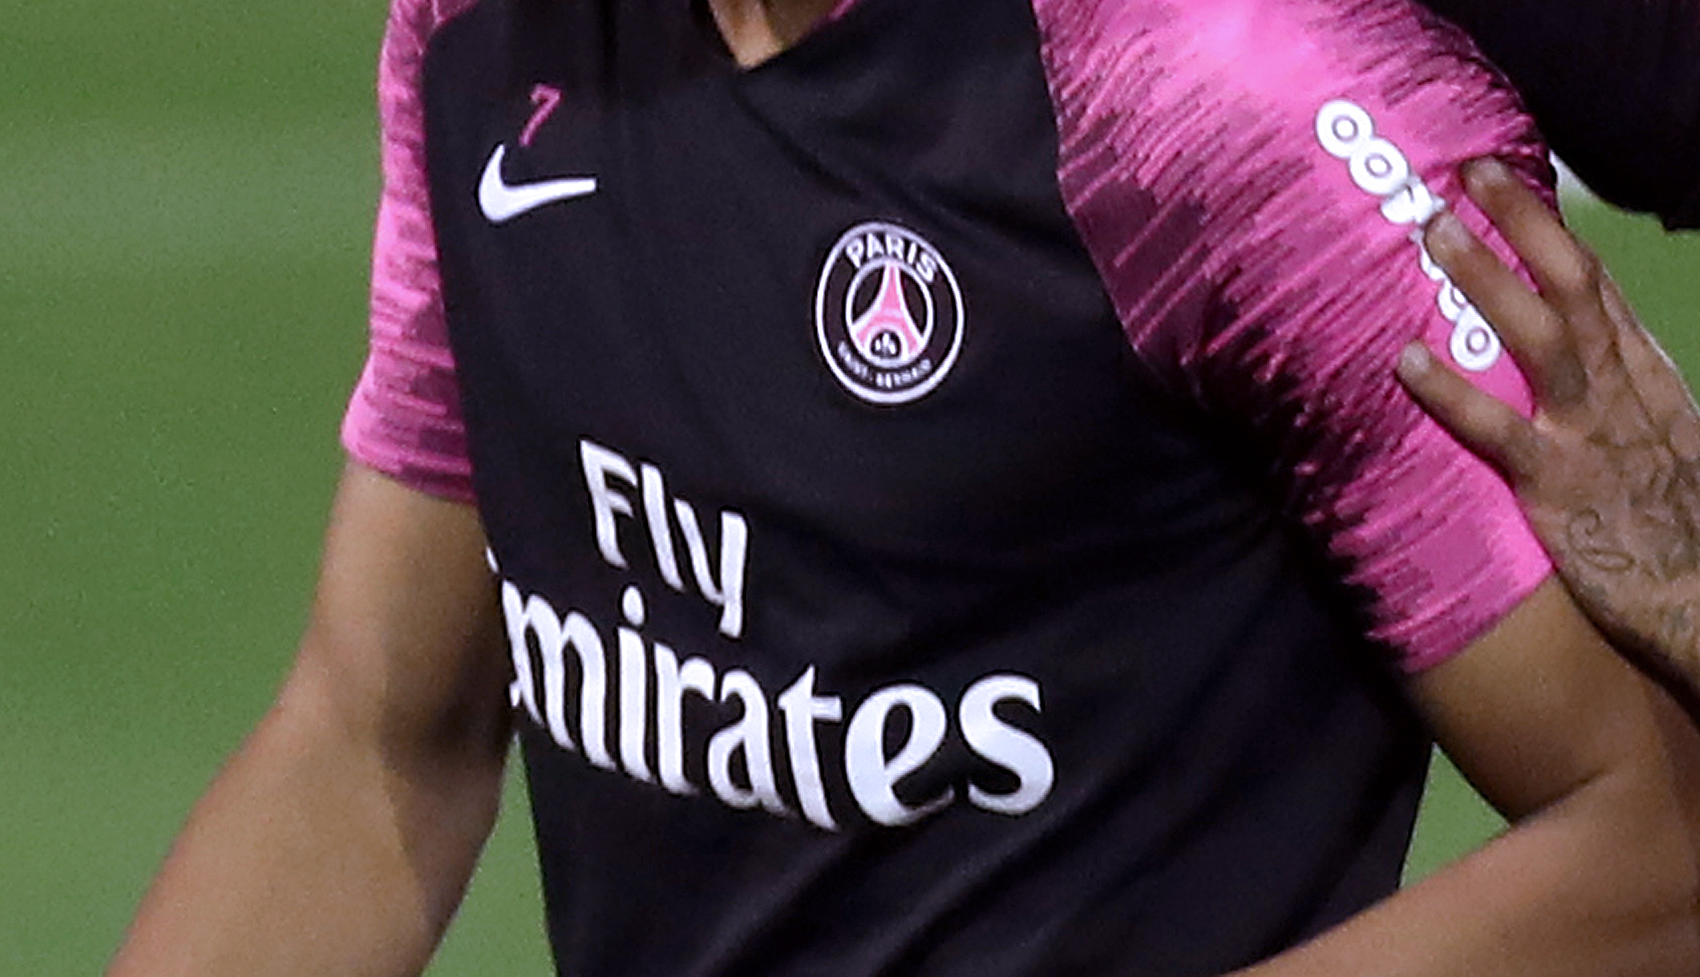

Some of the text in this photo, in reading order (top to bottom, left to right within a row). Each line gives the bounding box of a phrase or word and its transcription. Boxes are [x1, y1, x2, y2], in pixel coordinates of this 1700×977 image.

[518, 83, 562, 147] 7
[845, 232, 938, 283] PARIS
[580, 440, 748, 638] Fly
[486, 547, 1055, 830] mirates
